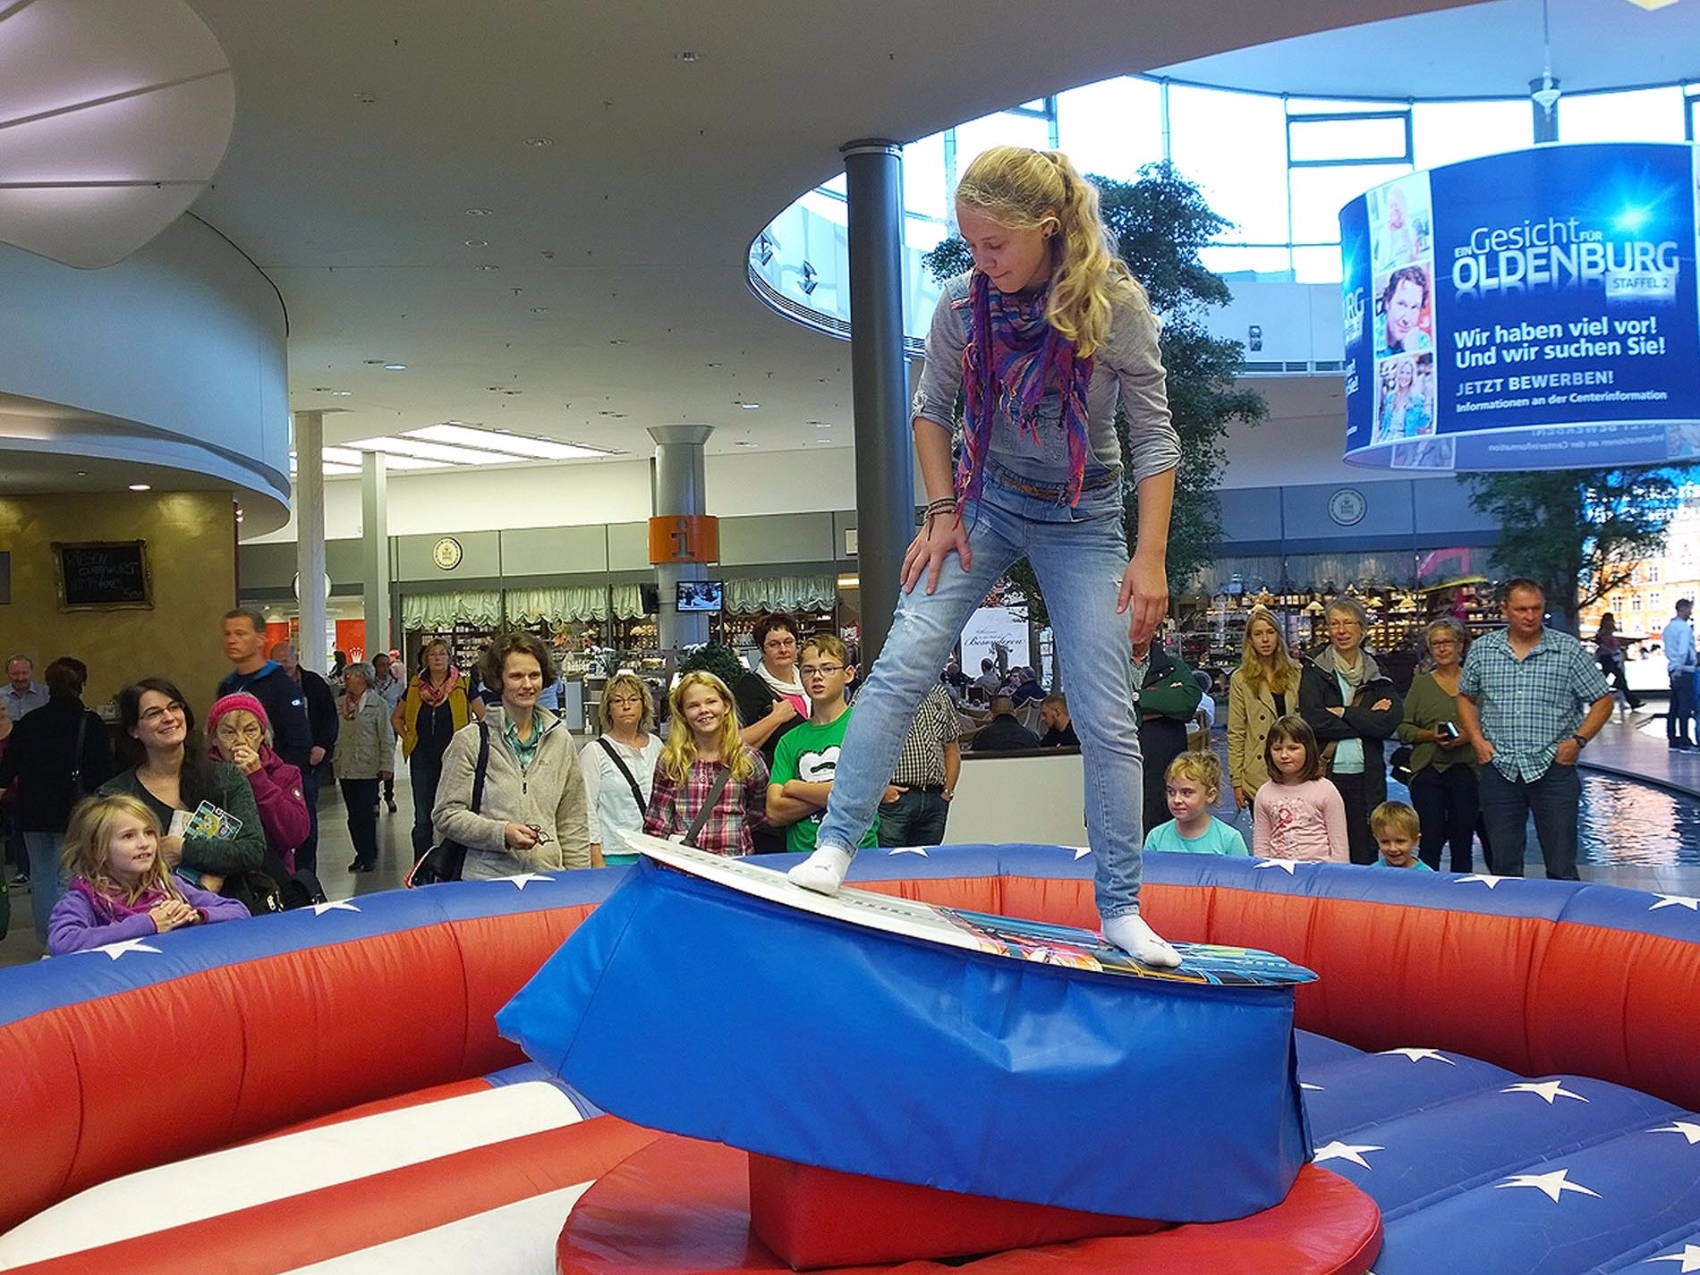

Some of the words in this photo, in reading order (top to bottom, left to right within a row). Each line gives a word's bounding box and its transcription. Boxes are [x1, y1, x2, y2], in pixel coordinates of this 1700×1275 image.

[1454, 246, 1473, 258] EIN
[1471, 217, 1580, 255] Gesicht
[1580, 231, 1603, 242] FÜR
[1452, 241, 1680, 290] OLDENBURG
[1613, 277, 1659, 290] STAFFEL
[1662, 276, 1671, 289] 2
[1454, 328, 1490, 349] Wir
[1495, 321, 1563, 344] haben
[1568, 316, 1609, 337] viel
[1613, 316, 1658, 335] vor!
[1456, 346, 1497, 369] Und
[1502, 343, 1540, 363] wir
[1544, 338, 1621, 359] suchen
[1627, 337, 1666, 355] Sie!
[1456, 379, 1504, 396] JETZT
[1508, 370, 1614, 391] BEWERBEN!
[1456, 398, 1530, 413] Informationen
[1531, 396, 1547, 405] an
[1548, 394, 1567, 405] der
[1569, 390, 1668, 404] Centerinformation
